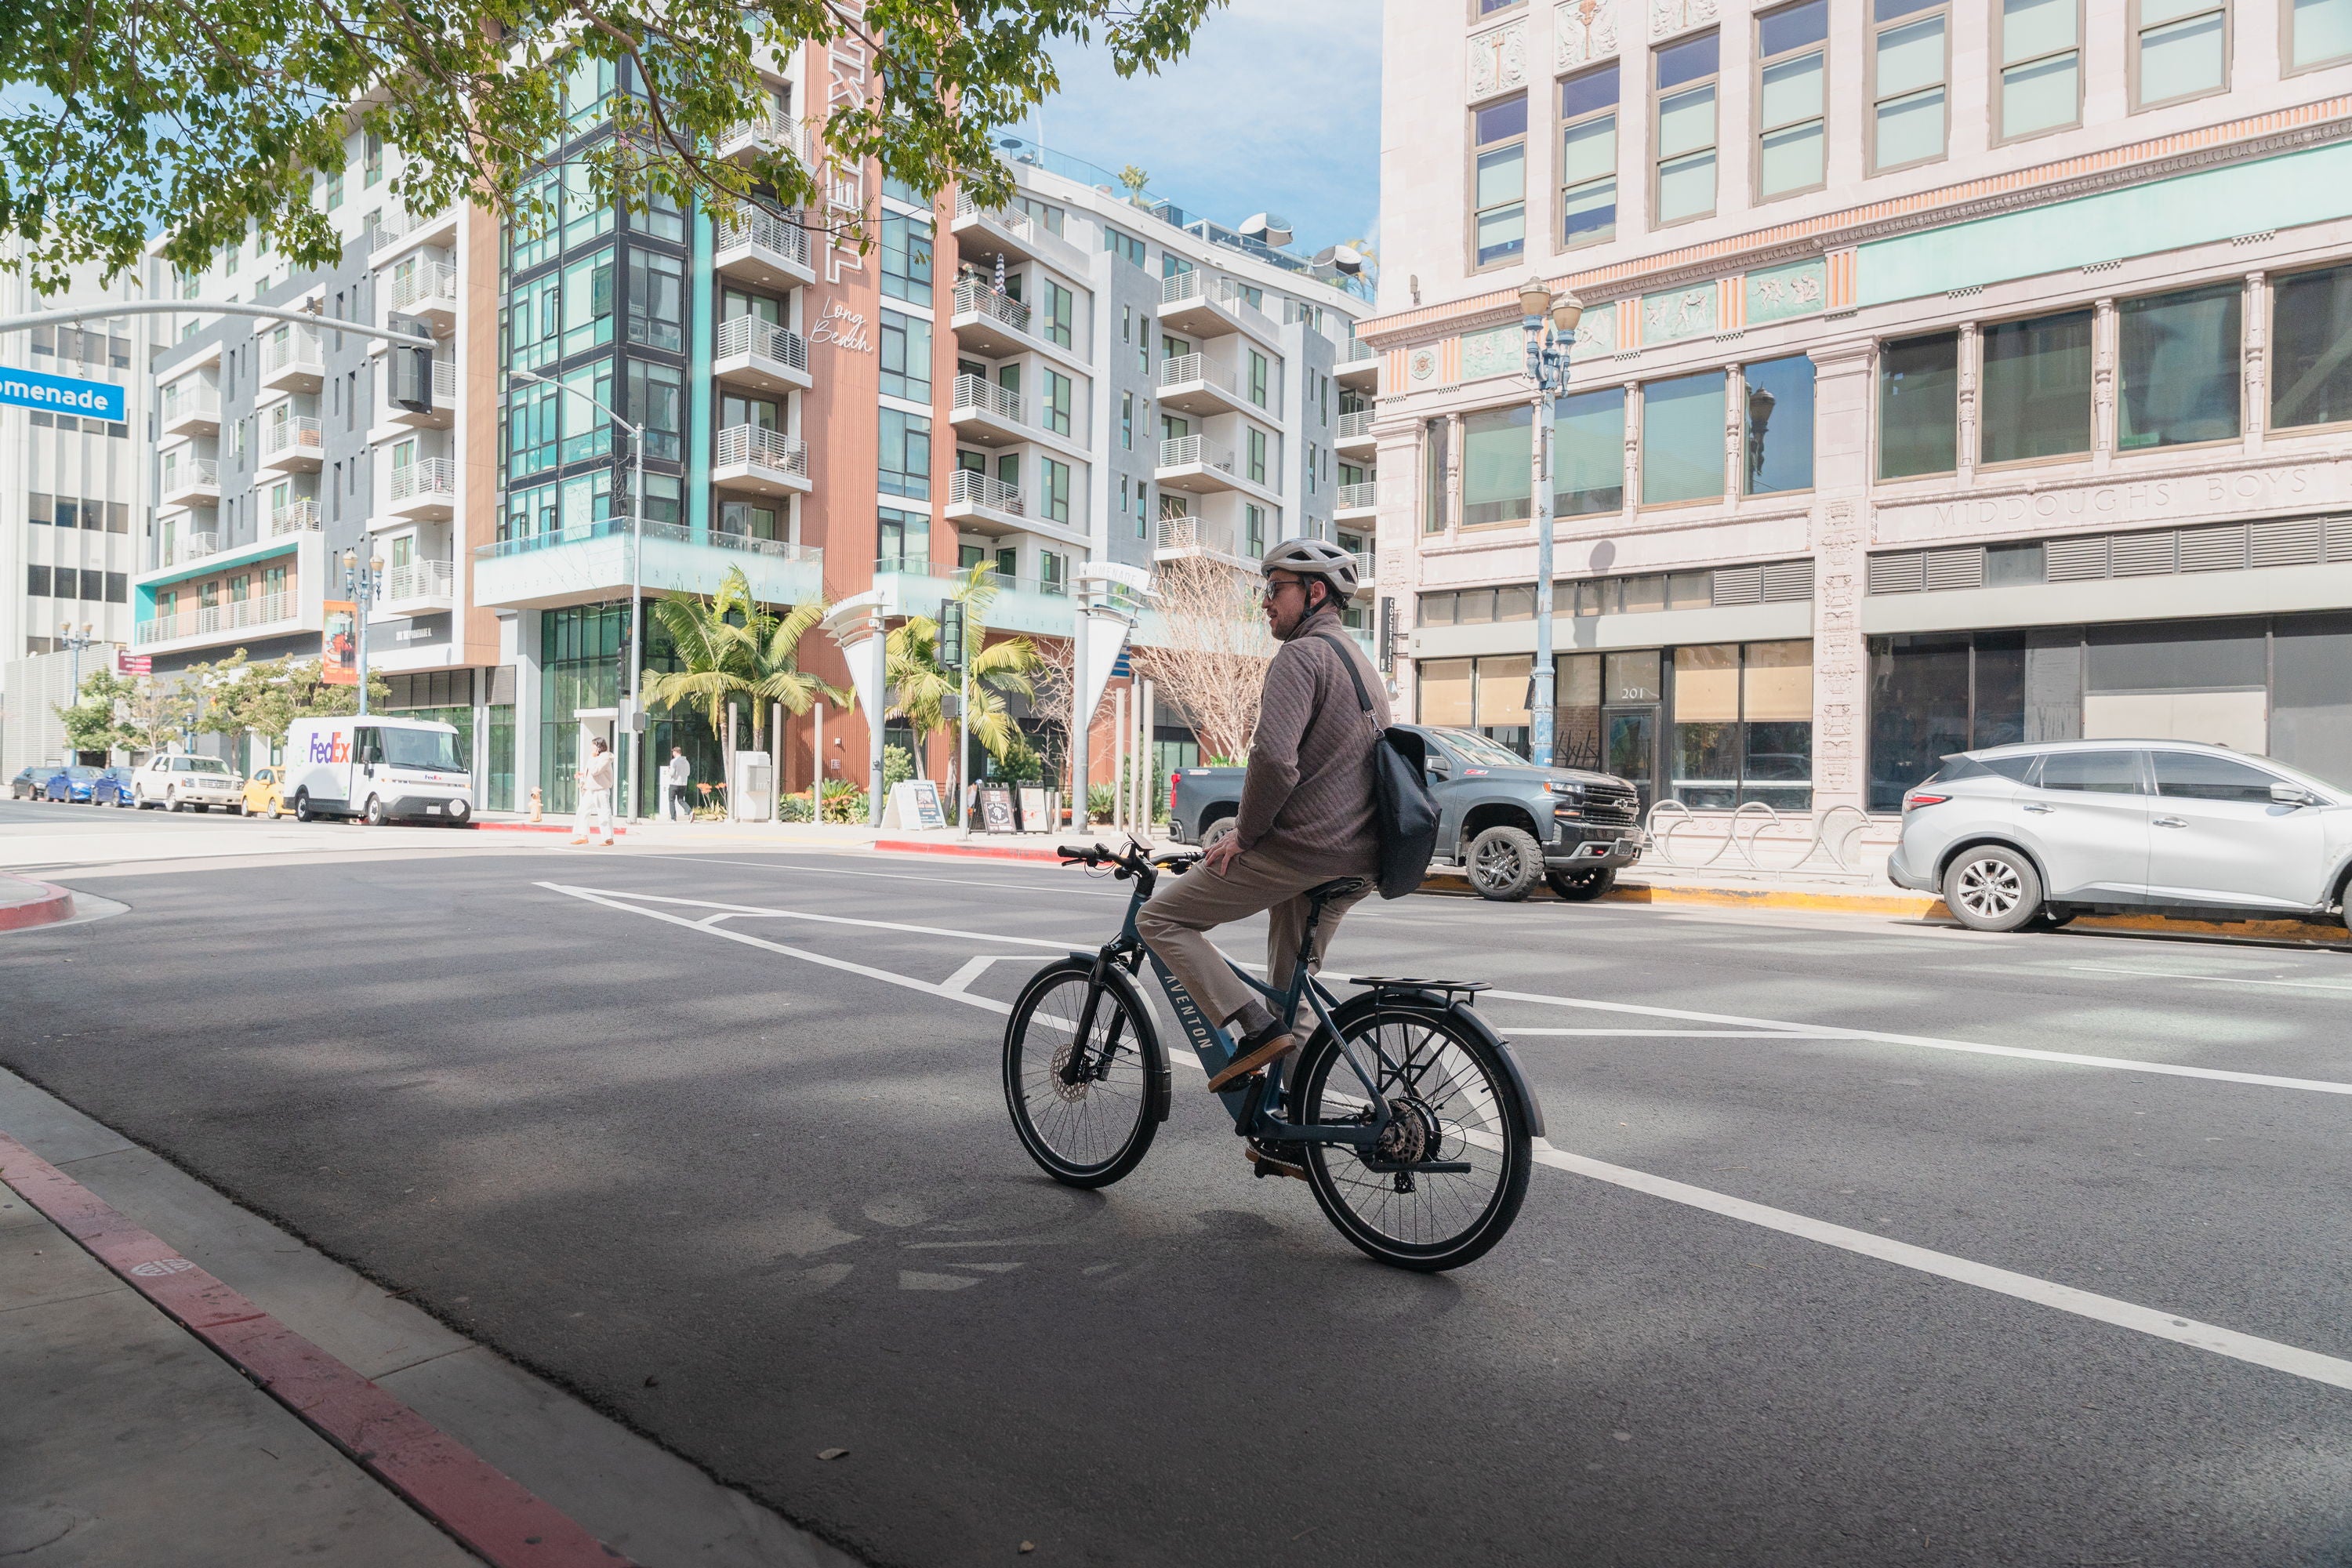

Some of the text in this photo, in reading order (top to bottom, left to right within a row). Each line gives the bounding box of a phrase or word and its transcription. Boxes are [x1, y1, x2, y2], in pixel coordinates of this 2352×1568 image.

[810, 318, 873, 352] Beach
[823, 296, 866, 341] Long
[0, 380, 109, 411] menade
[1621, 688, 1643, 699] 201
[309, 731, 350, 764] FedEx
[1164, 975, 1213, 1049] AVENTON
